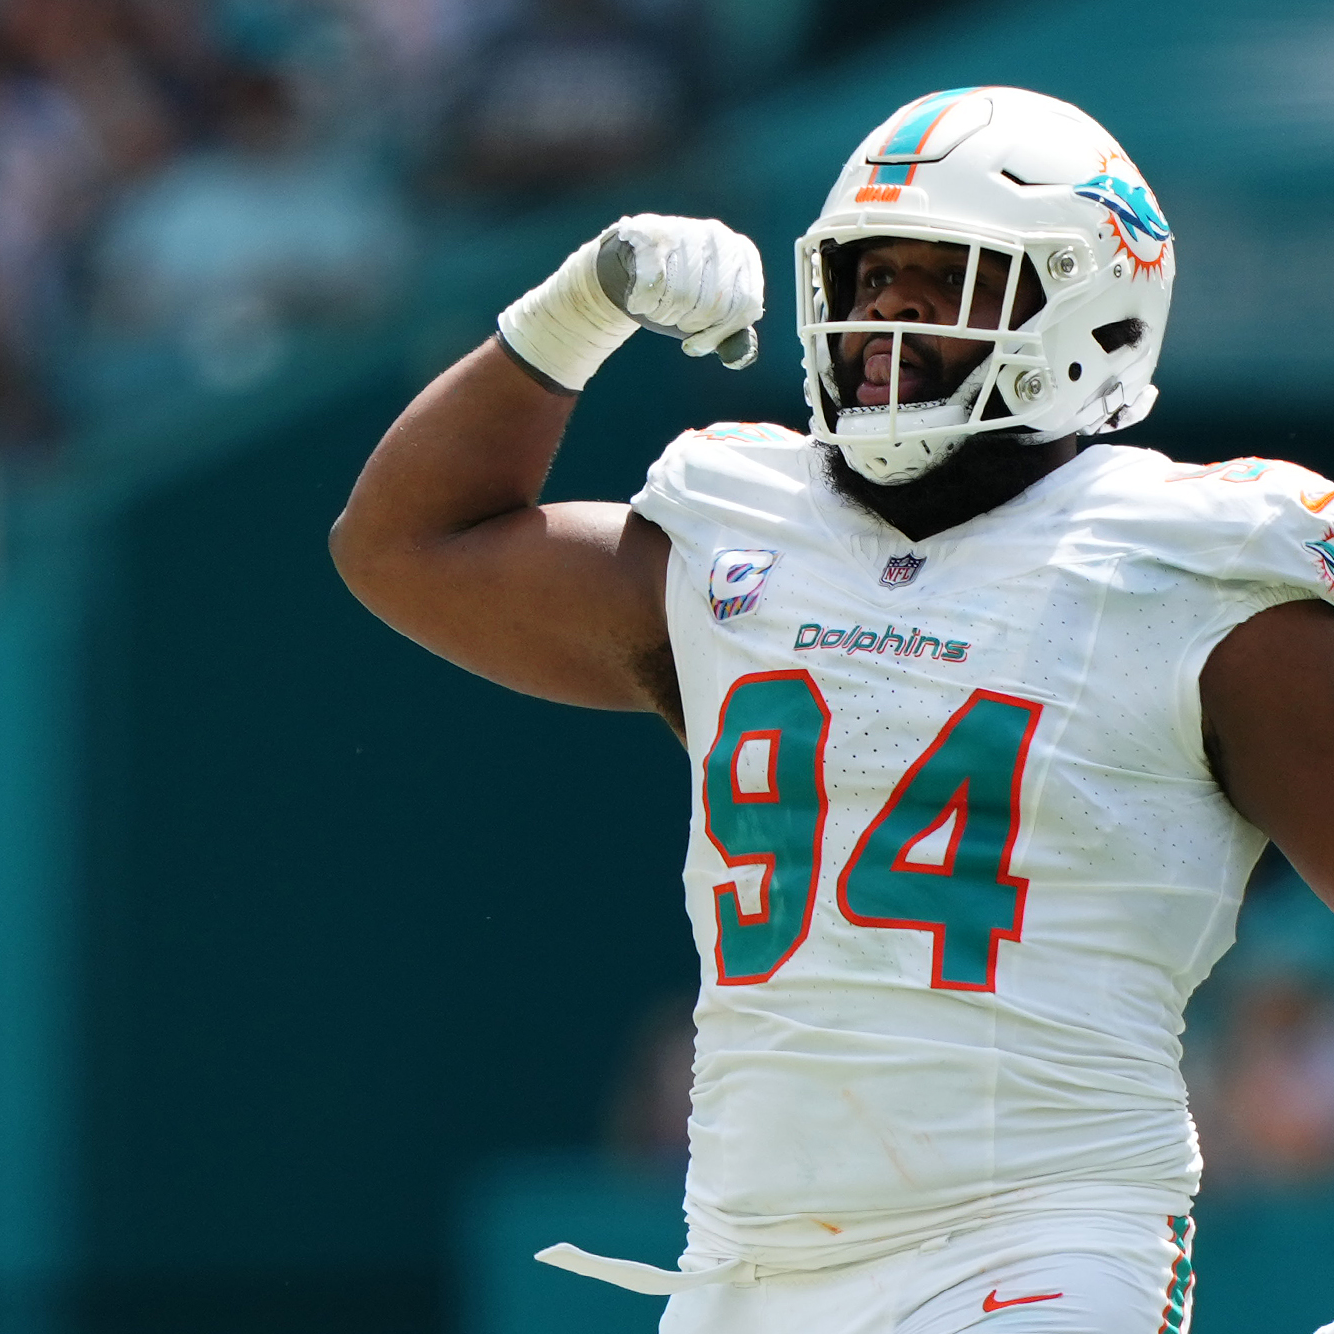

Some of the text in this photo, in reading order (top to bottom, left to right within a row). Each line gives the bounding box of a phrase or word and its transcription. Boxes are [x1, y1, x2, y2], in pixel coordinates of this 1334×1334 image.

[884, 567, 910, 582] NFL
[794, 623, 971, 663] Dolphins
[702, 669, 1044, 993] 94
